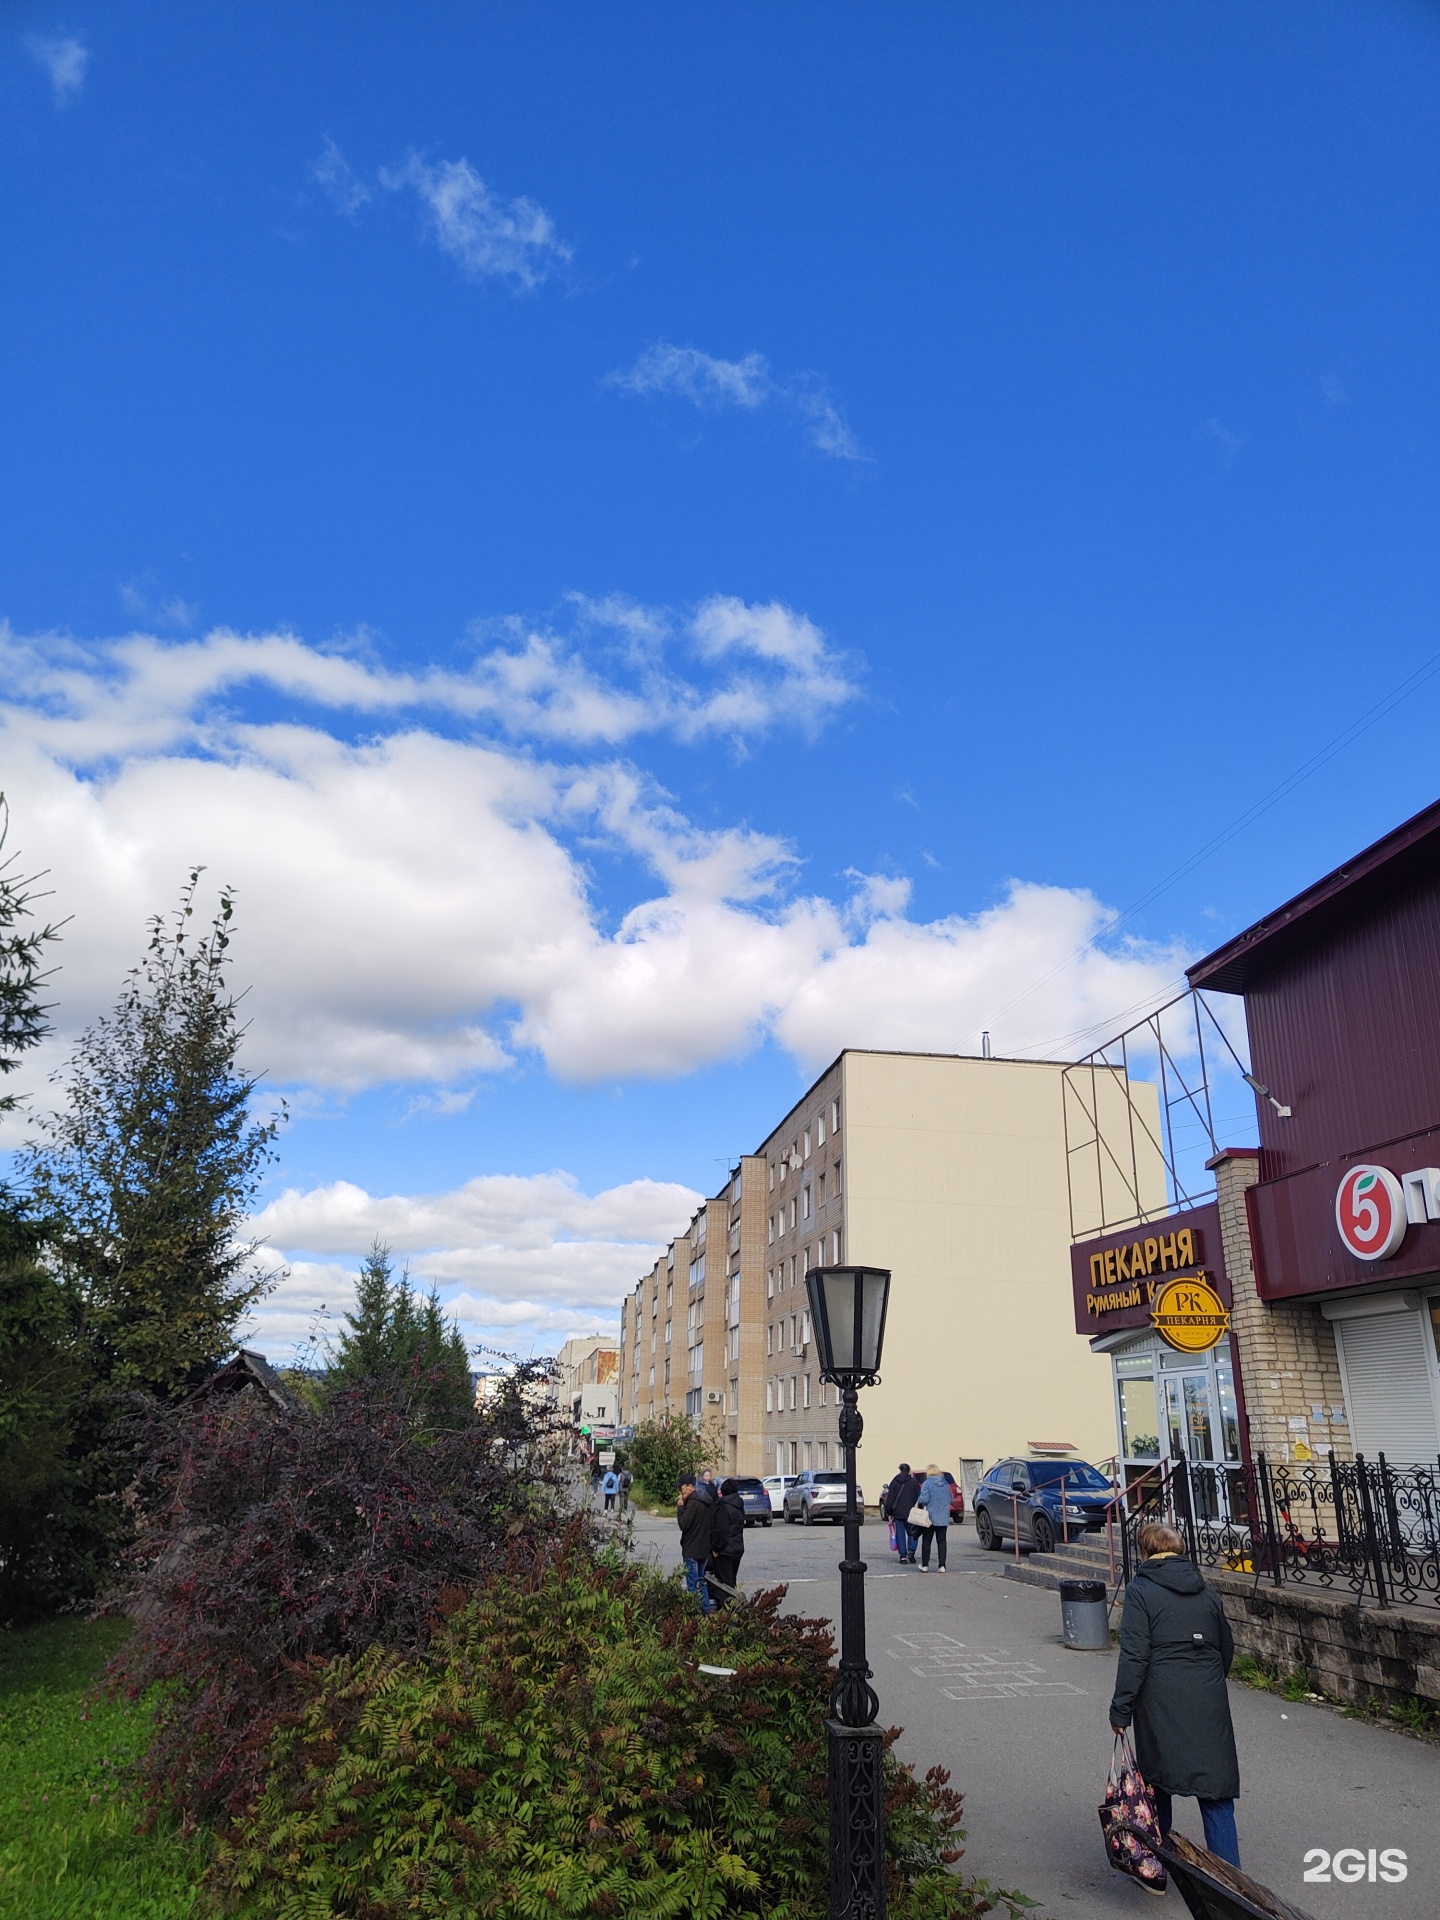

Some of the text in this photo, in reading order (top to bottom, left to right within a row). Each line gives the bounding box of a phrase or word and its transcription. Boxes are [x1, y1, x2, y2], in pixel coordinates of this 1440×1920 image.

[1401, 1167, 1440, 1225] П
[1089, 1228, 1194, 1288] ПЕКАРНЯ
[1086, 1282, 1141, 1318] Румяный
[1166, 1316, 1217, 1325] ПЕКАРНЯ
